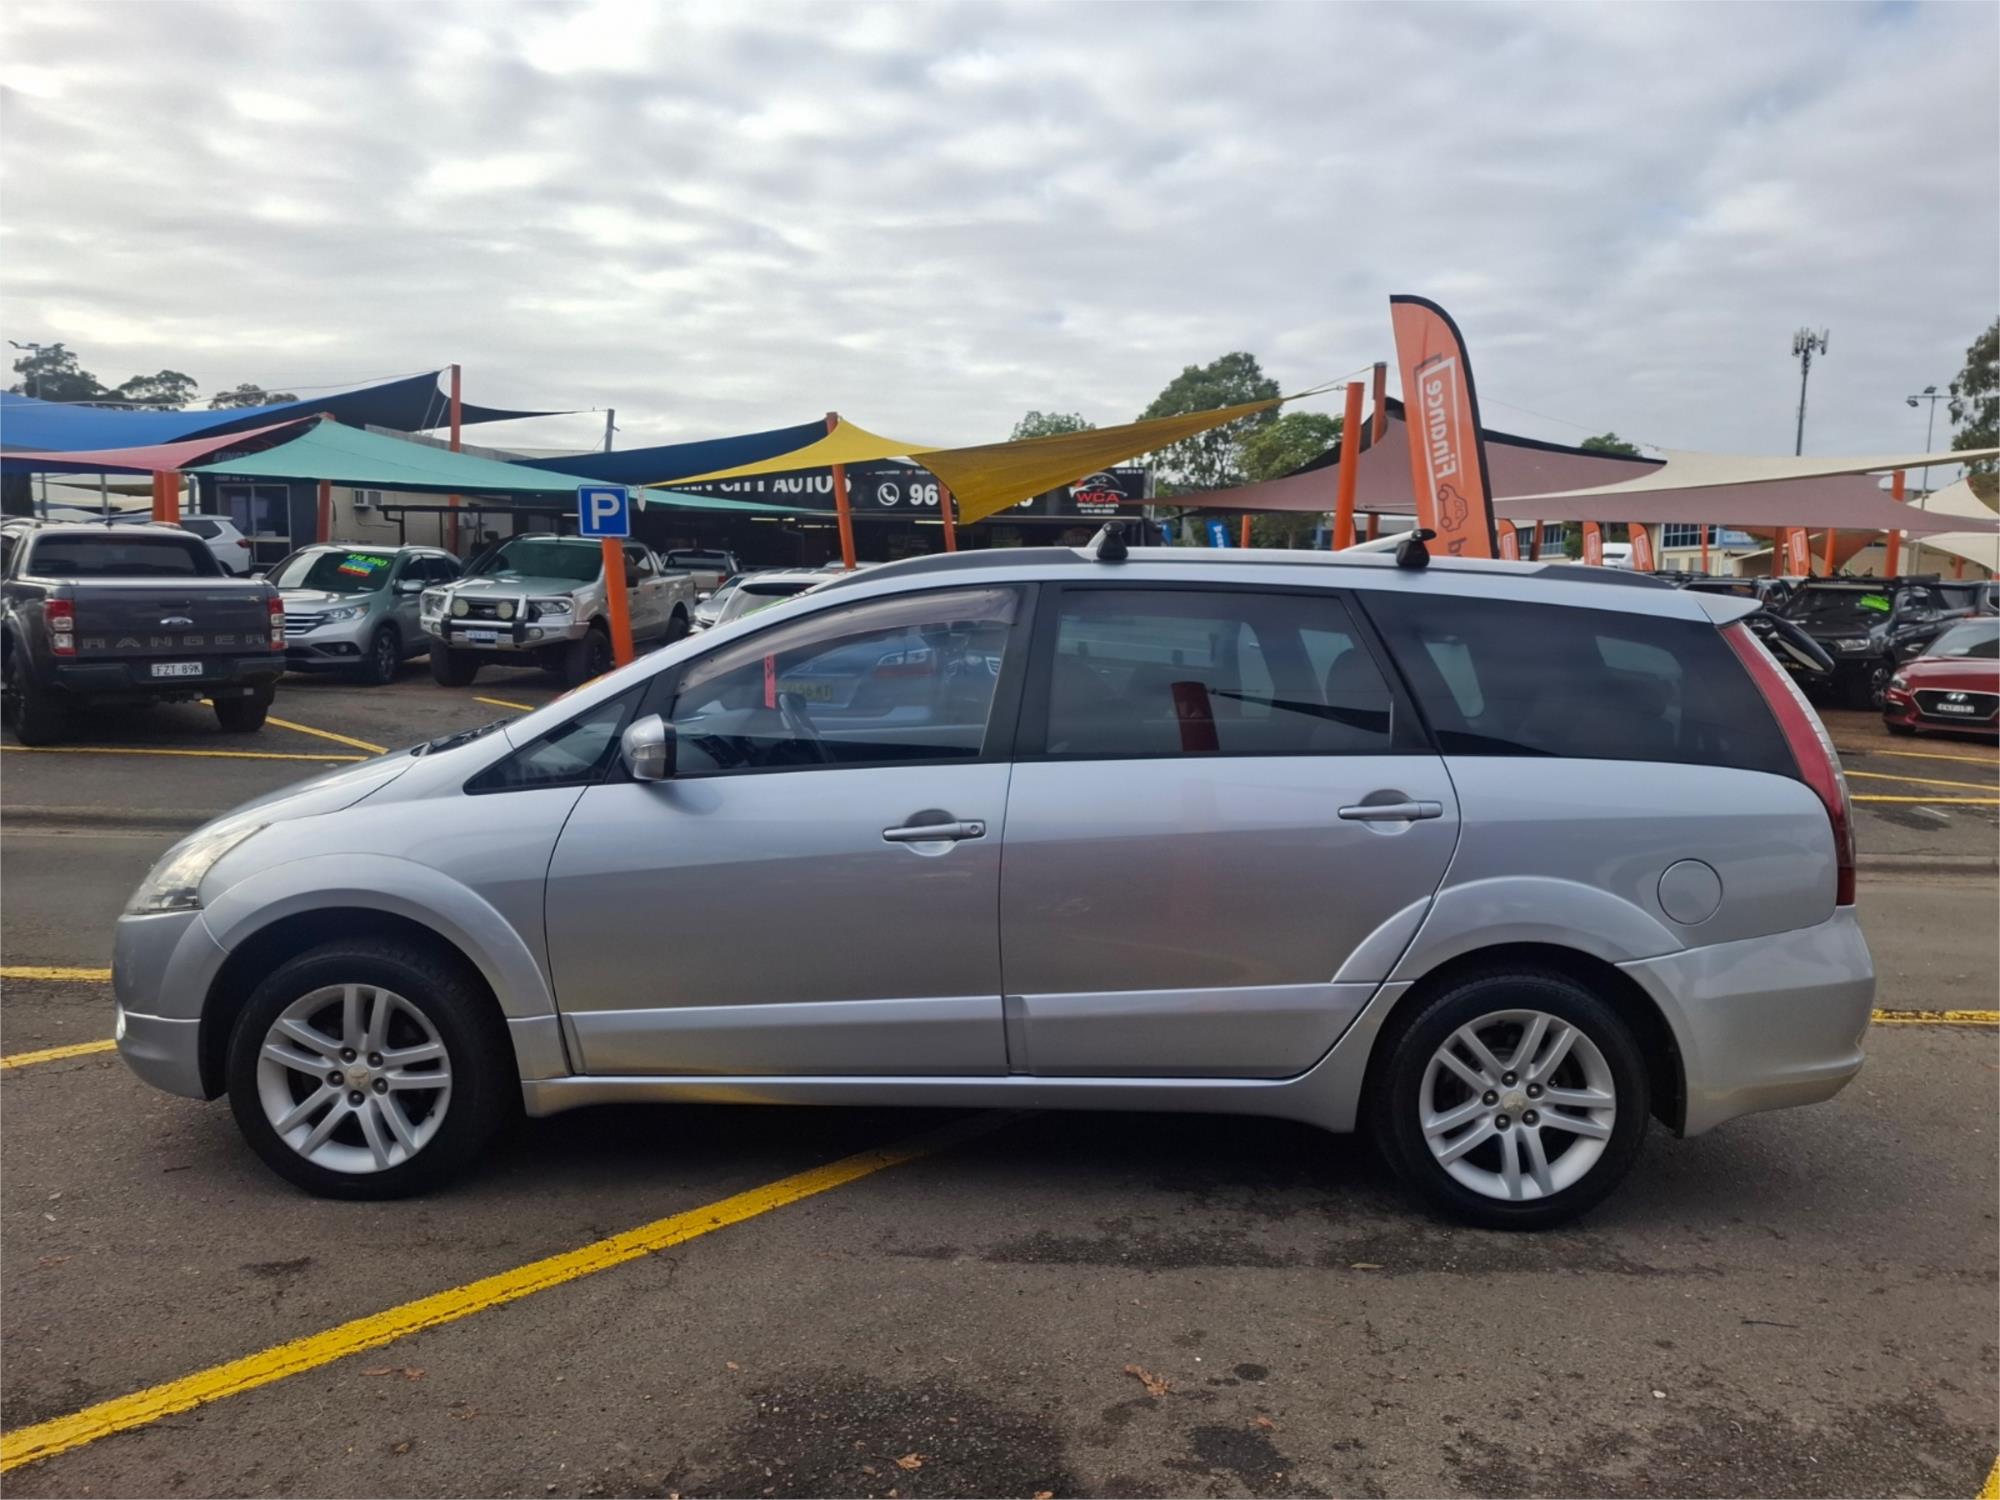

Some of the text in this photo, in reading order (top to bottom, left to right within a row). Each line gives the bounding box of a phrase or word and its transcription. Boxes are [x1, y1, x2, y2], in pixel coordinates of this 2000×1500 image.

[1076, 492, 1120, 503] WCA
[590, 493, 620, 530] P
[83, 634, 265, 649] RANGER
